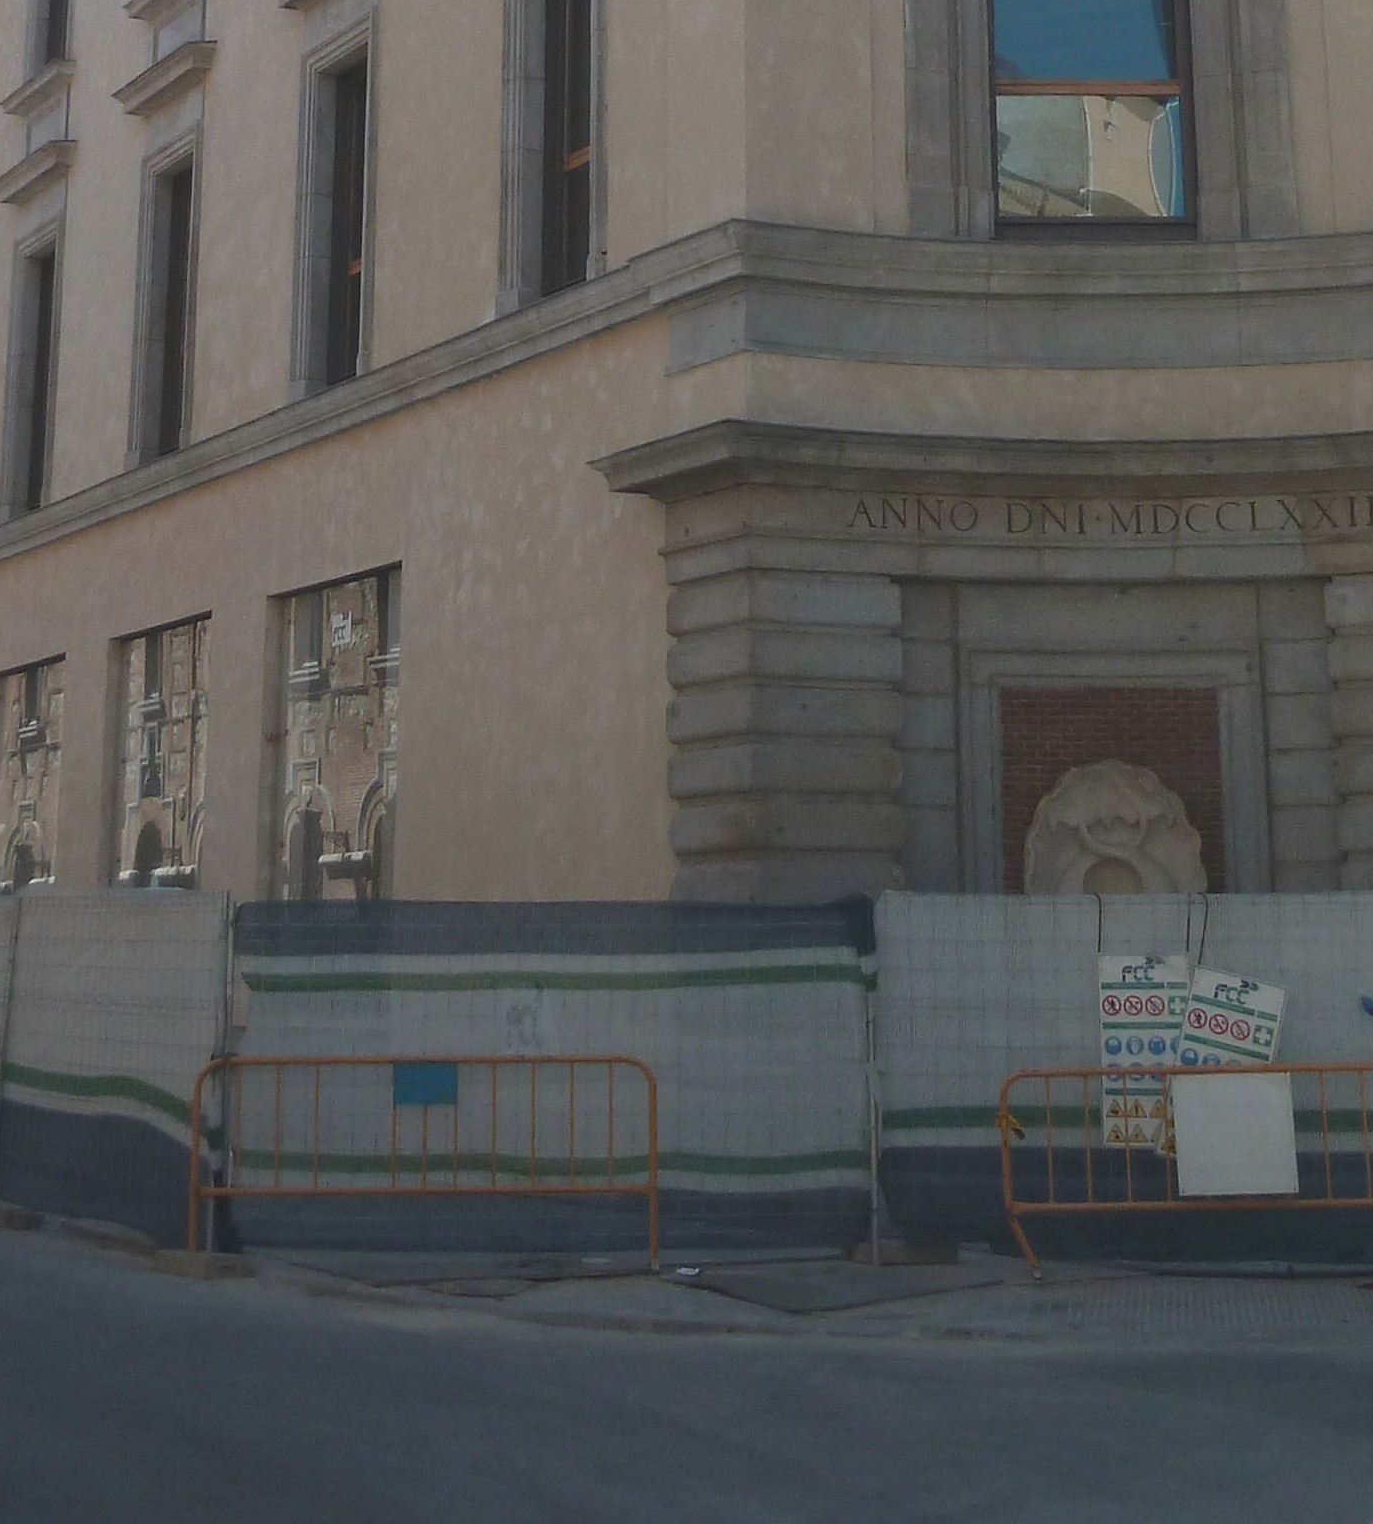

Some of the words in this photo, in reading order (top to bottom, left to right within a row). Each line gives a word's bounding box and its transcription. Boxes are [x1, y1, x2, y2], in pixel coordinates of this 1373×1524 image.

[848, 497, 978, 532] ANNO
[1121, 965, 1155, 982] FCC
[1214, 983, 1250, 1005] FCC
